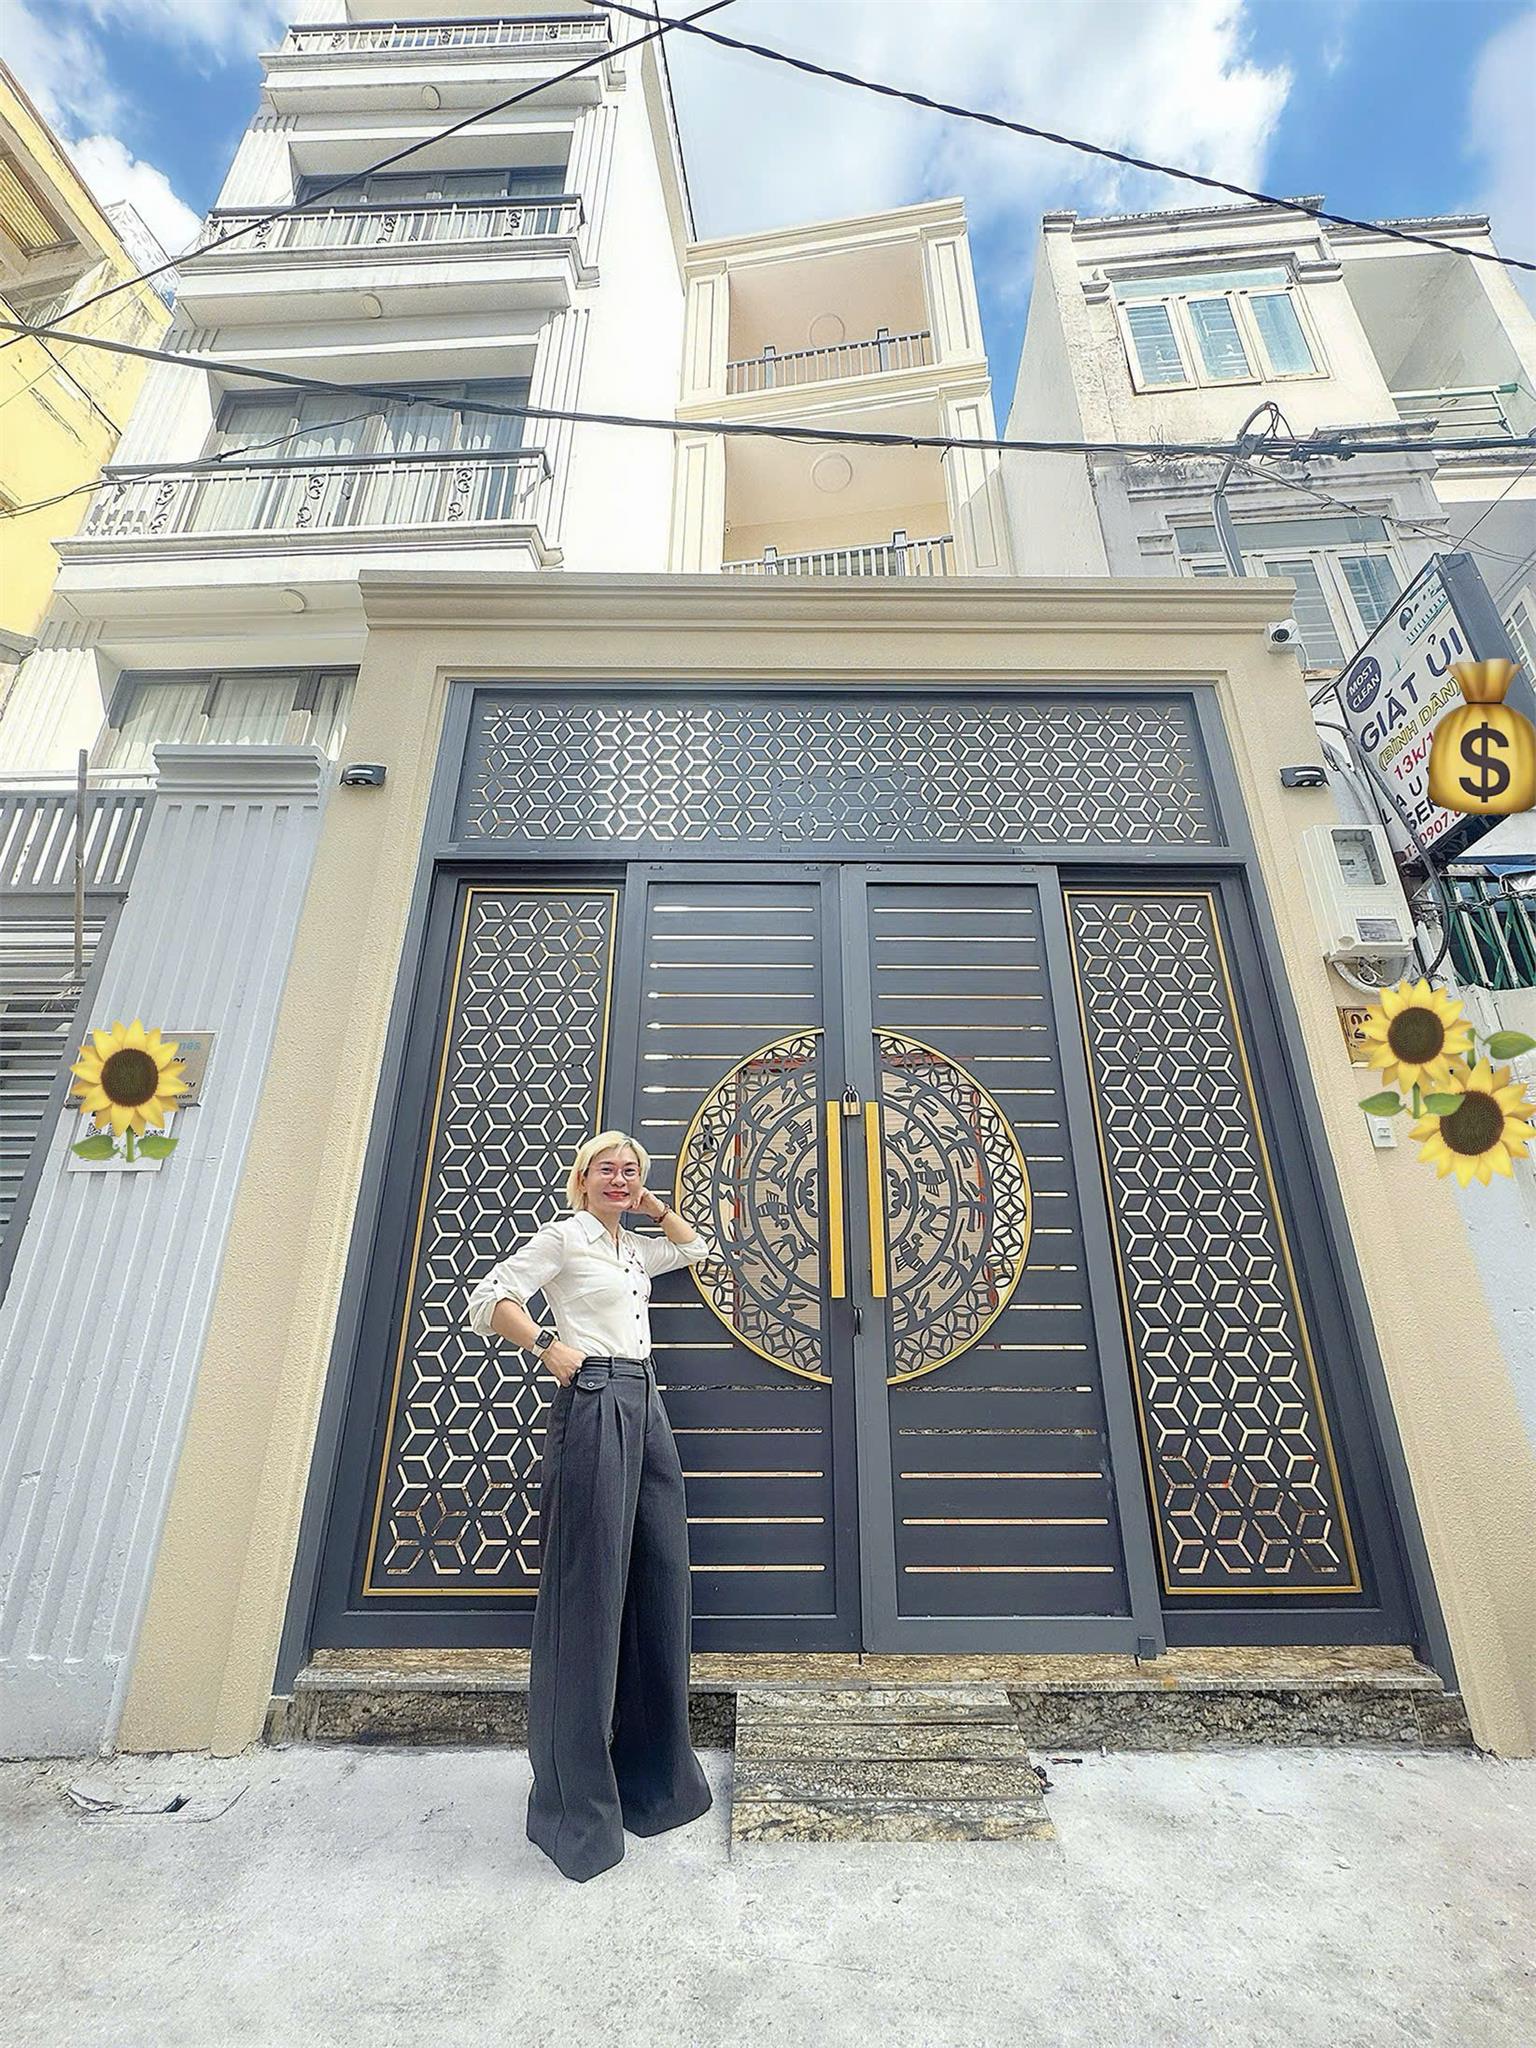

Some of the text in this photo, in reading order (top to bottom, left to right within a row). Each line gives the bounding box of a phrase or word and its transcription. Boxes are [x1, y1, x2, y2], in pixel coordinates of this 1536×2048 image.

[1426, 627, 1463, 677] ỦI
[1349, 661, 1373, 696] MOST
[1352, 674, 1380, 708] CLEAN
[1418, 676, 1460, 727] DÂN)
[1382, 766, 1430, 824] LAU
